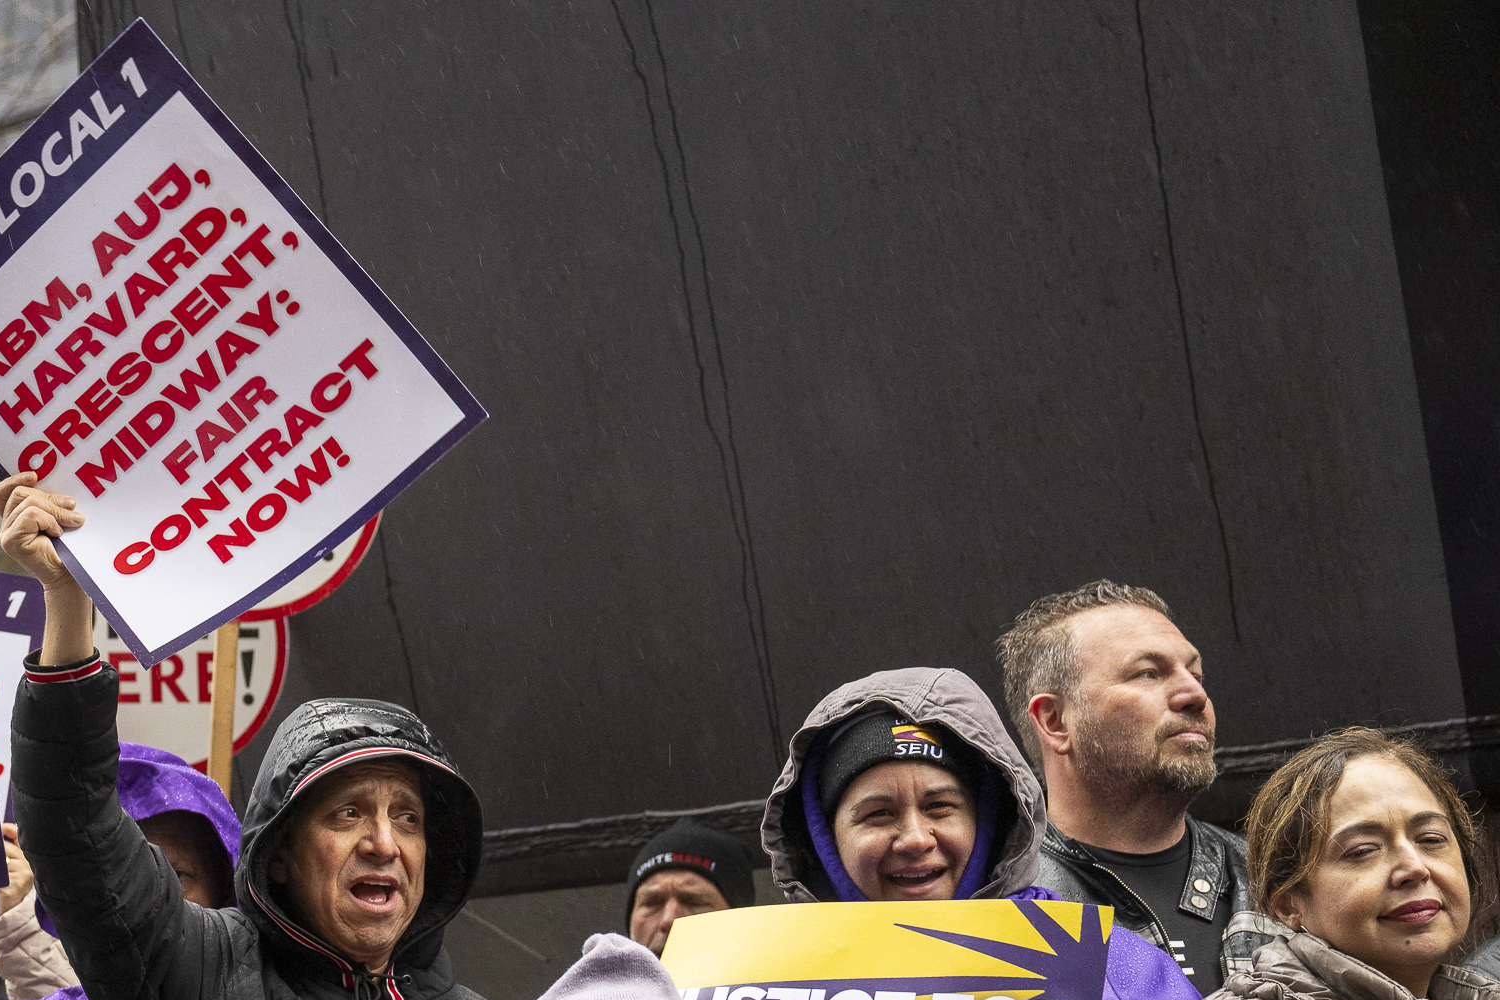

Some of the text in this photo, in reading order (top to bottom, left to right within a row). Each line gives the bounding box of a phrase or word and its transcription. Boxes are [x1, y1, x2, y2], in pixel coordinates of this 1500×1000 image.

[120, 57, 150, 97] 1
[91, 162, 211, 277] AUJ,
[17, 223, 299, 481] CRESCENT,
[74, 288, 301, 499] MIDWAY:
[113, 339, 381, 576] CONTRACT
[160, 375, 279, 486] FAIR
[206, 436, 351, 564] NOW!
[108, 650, 255, 706] ERE!
[895, 742, 943, 759] SEIU
